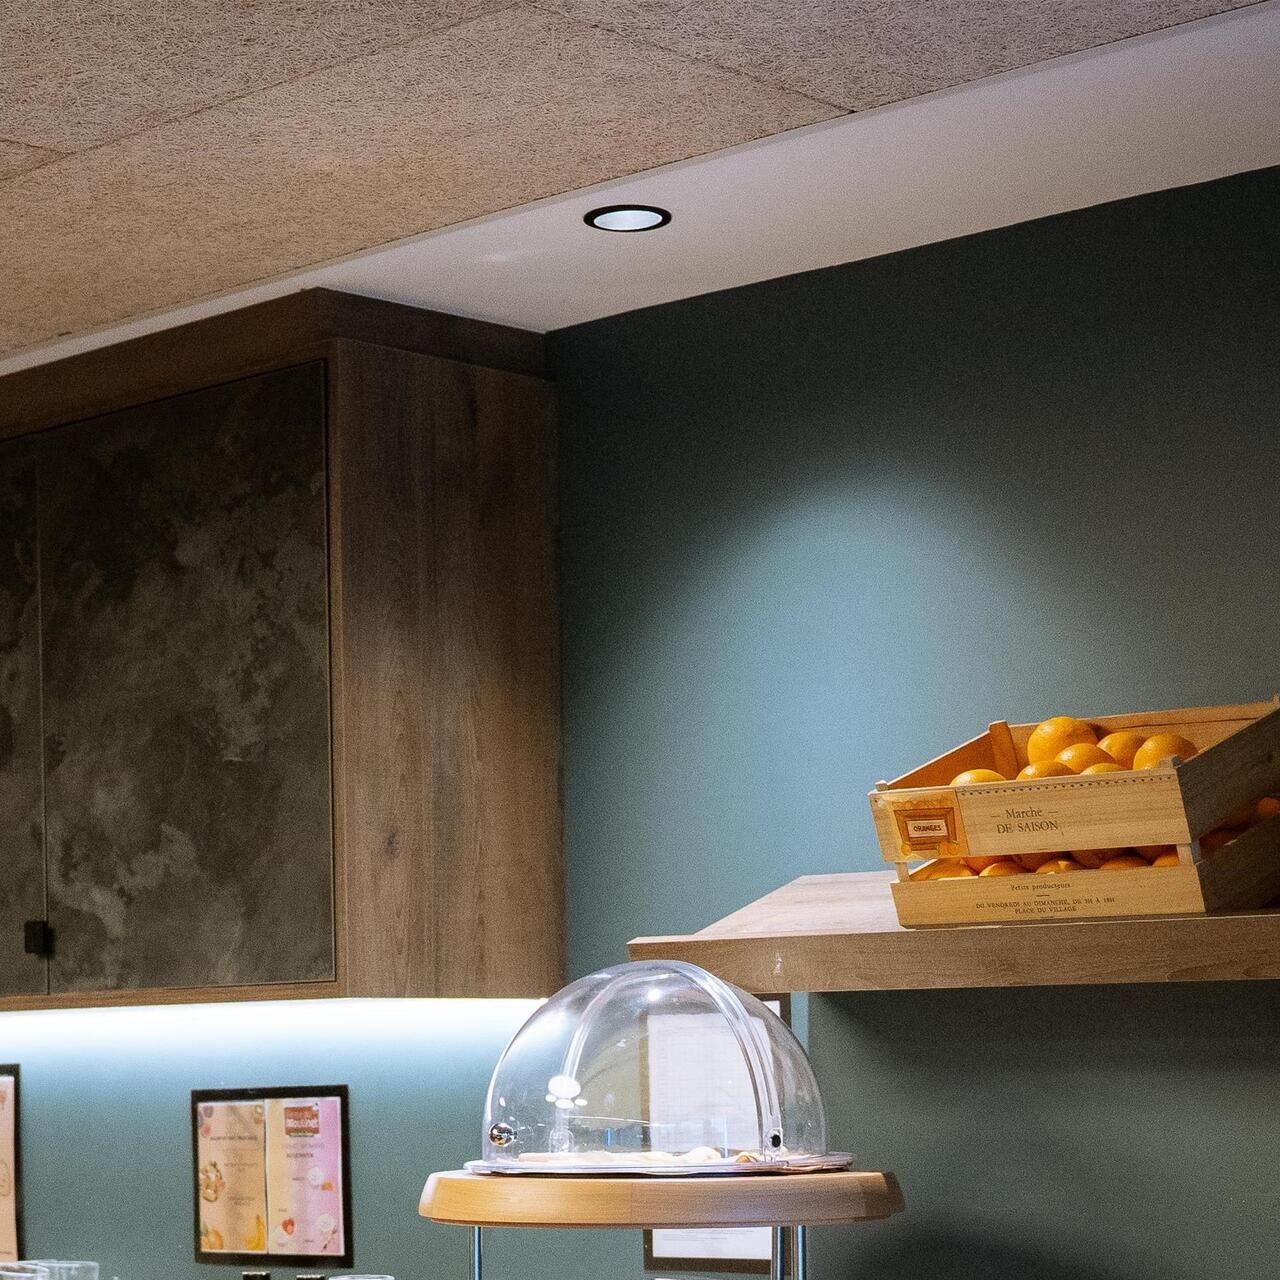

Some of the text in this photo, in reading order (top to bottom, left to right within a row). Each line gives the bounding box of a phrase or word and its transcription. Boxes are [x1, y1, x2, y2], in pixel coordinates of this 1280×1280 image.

[1005, 807, 1043, 819] Marché
[913, 824, 943, 833] ORANGES
[997, 820, 1059, 834] DE SAISON
[1032, 883, 1071, 891] producteurs
